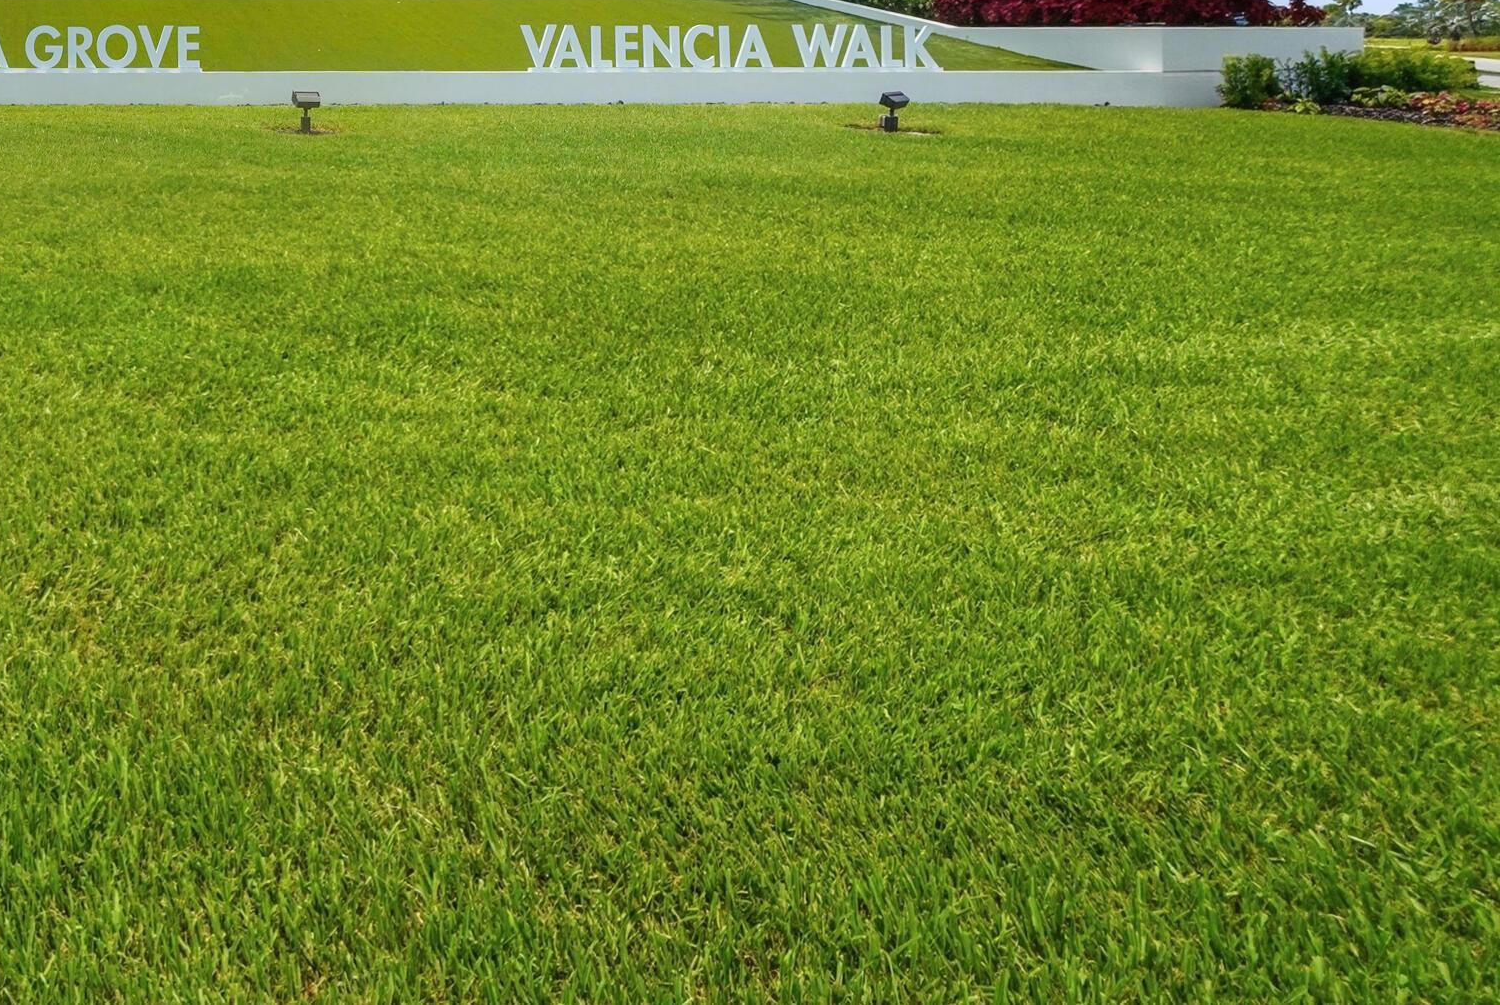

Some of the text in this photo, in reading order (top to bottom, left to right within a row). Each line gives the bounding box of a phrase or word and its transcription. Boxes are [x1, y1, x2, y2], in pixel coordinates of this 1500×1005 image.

[24, 25, 201, 69] GROVE
[520, 24, 939, 68] VALENCIA WALK
